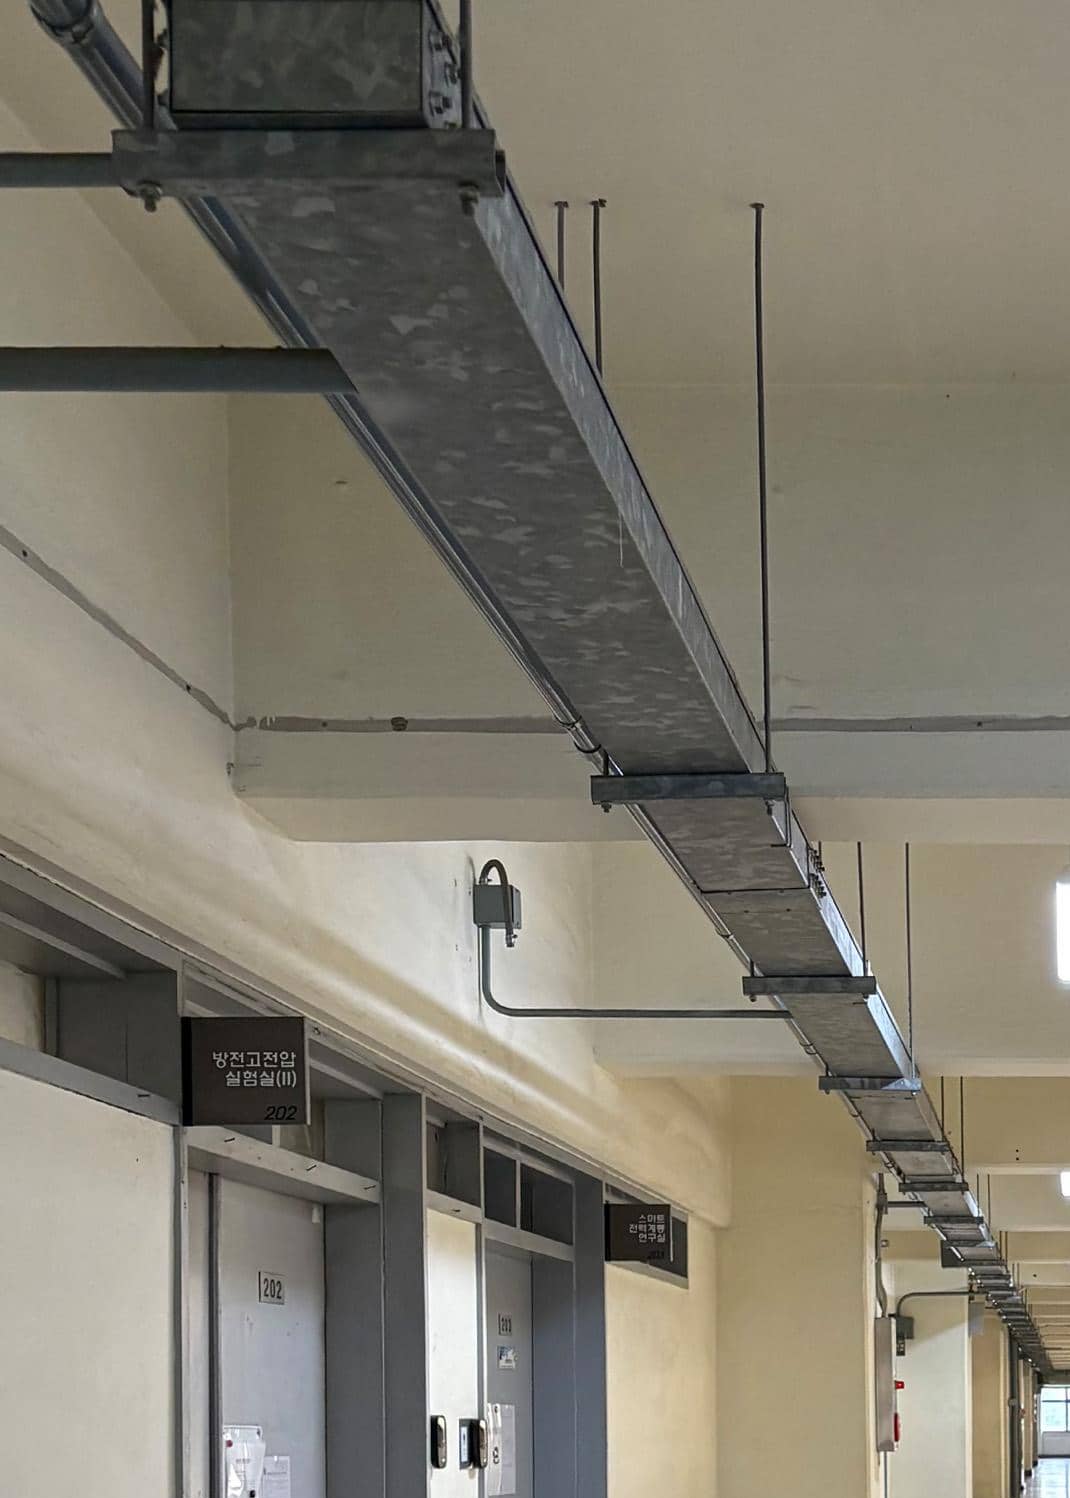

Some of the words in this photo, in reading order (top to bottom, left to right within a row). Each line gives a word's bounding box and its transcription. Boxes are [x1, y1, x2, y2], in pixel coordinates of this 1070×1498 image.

[212, 1051, 297, 1069] 방전고전압
[225, 1070, 297, 1088] 실험실(II)
[264, 1105, 298, 1121] 202
[638, 1233, 666, 1243] 연구실
[263, 1278, 282, 1299] 202
